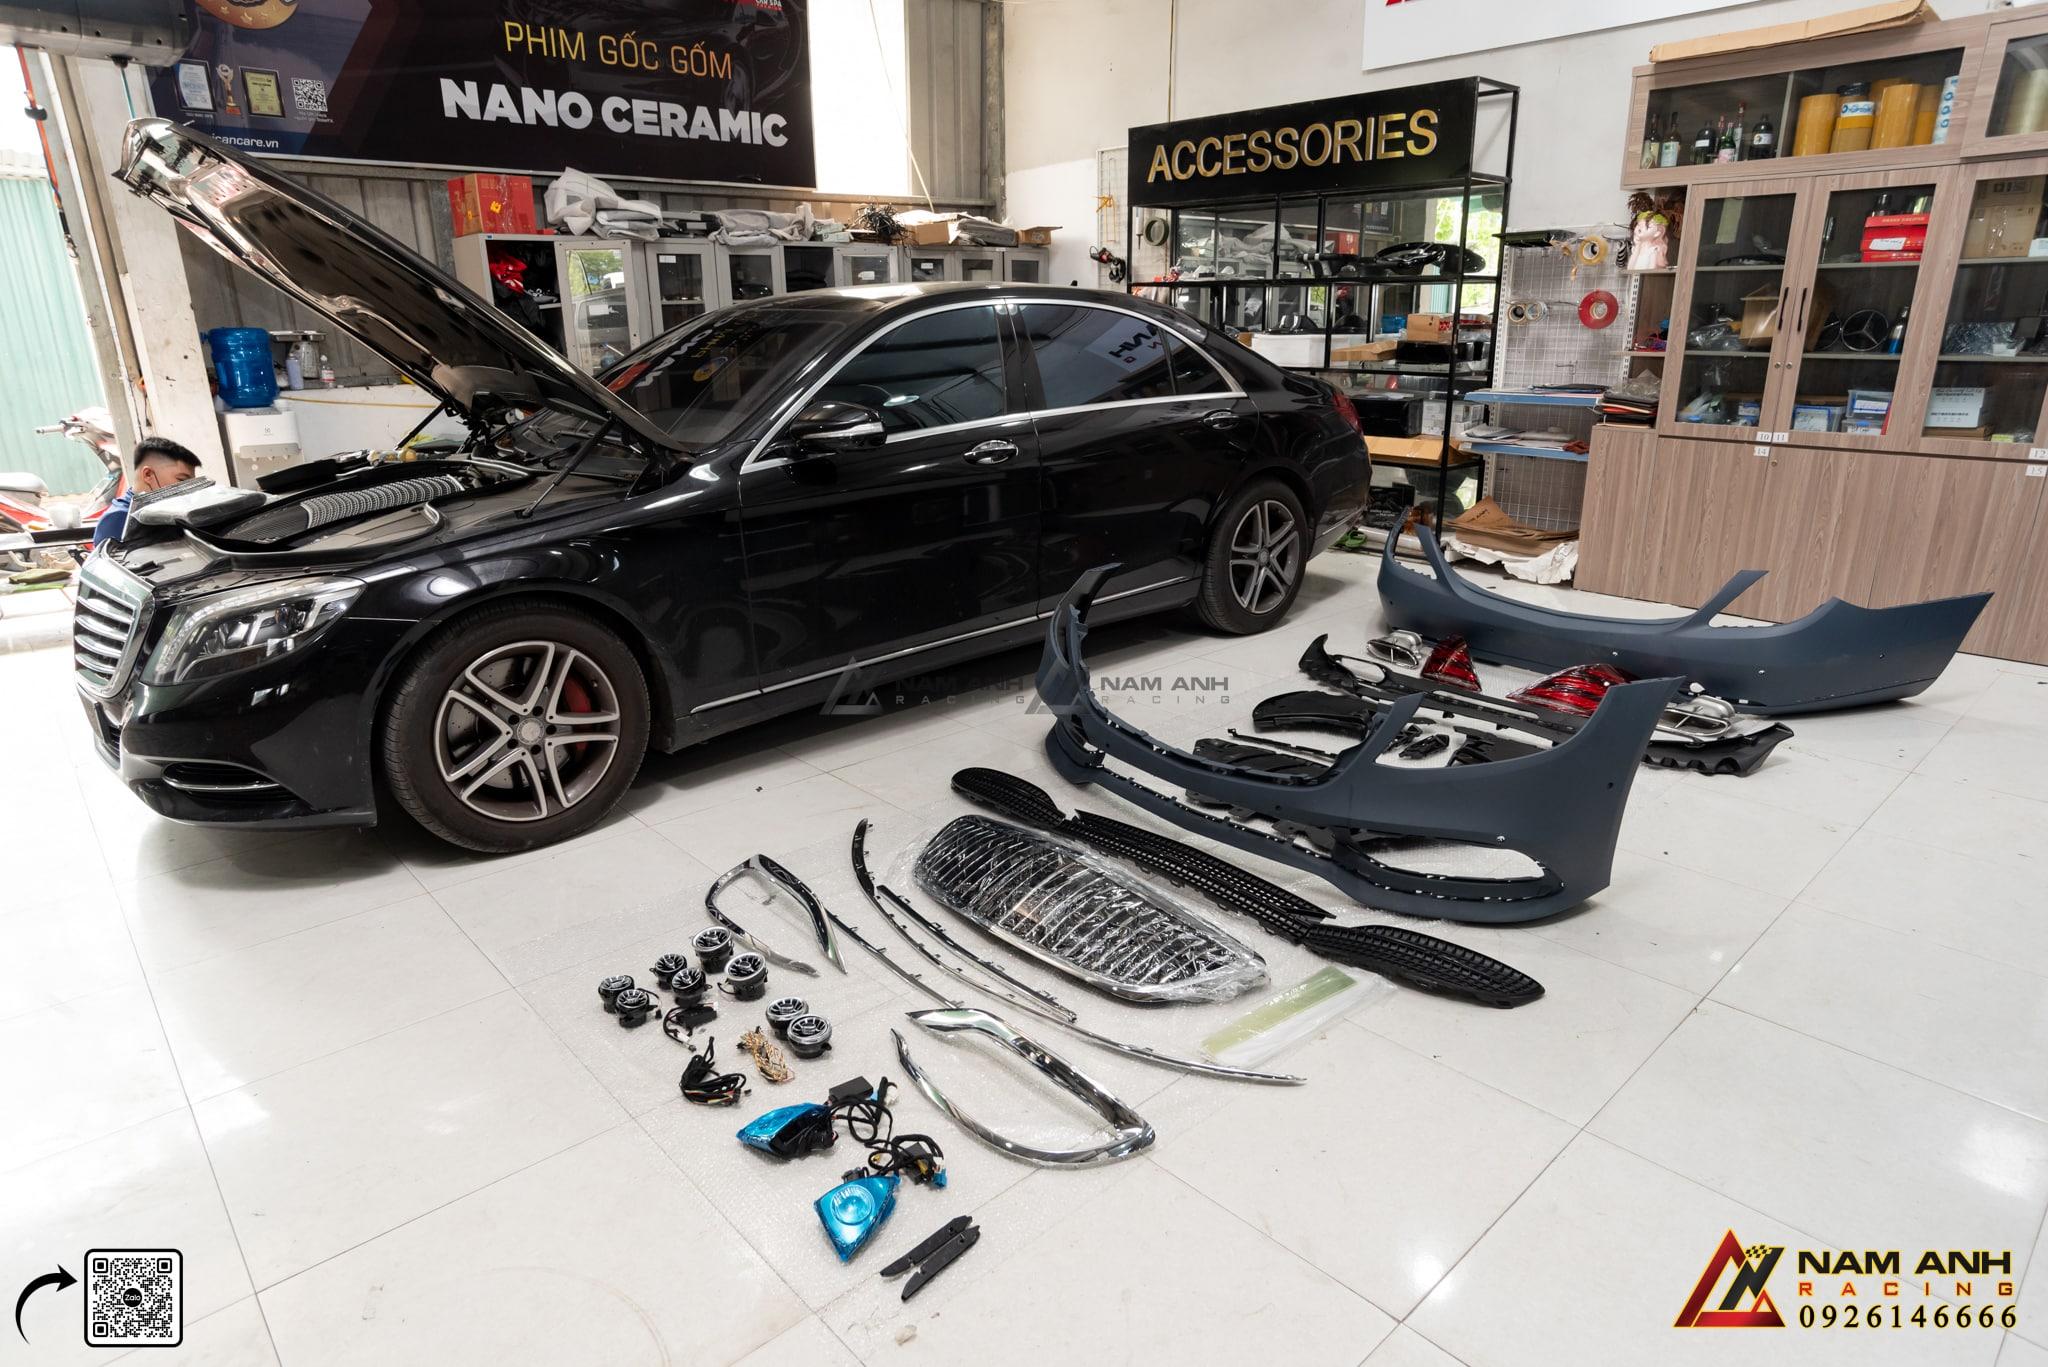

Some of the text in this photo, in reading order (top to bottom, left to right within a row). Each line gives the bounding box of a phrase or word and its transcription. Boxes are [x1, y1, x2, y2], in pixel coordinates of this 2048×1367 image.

[504, 20, 733, 81] PHIM GỐC GỐM
[440, 78, 789, 148] NANO CERAMIC
[1147, 108, 1440, 184] ACCESSORIES
[1760, 433, 1770, 441] 10
